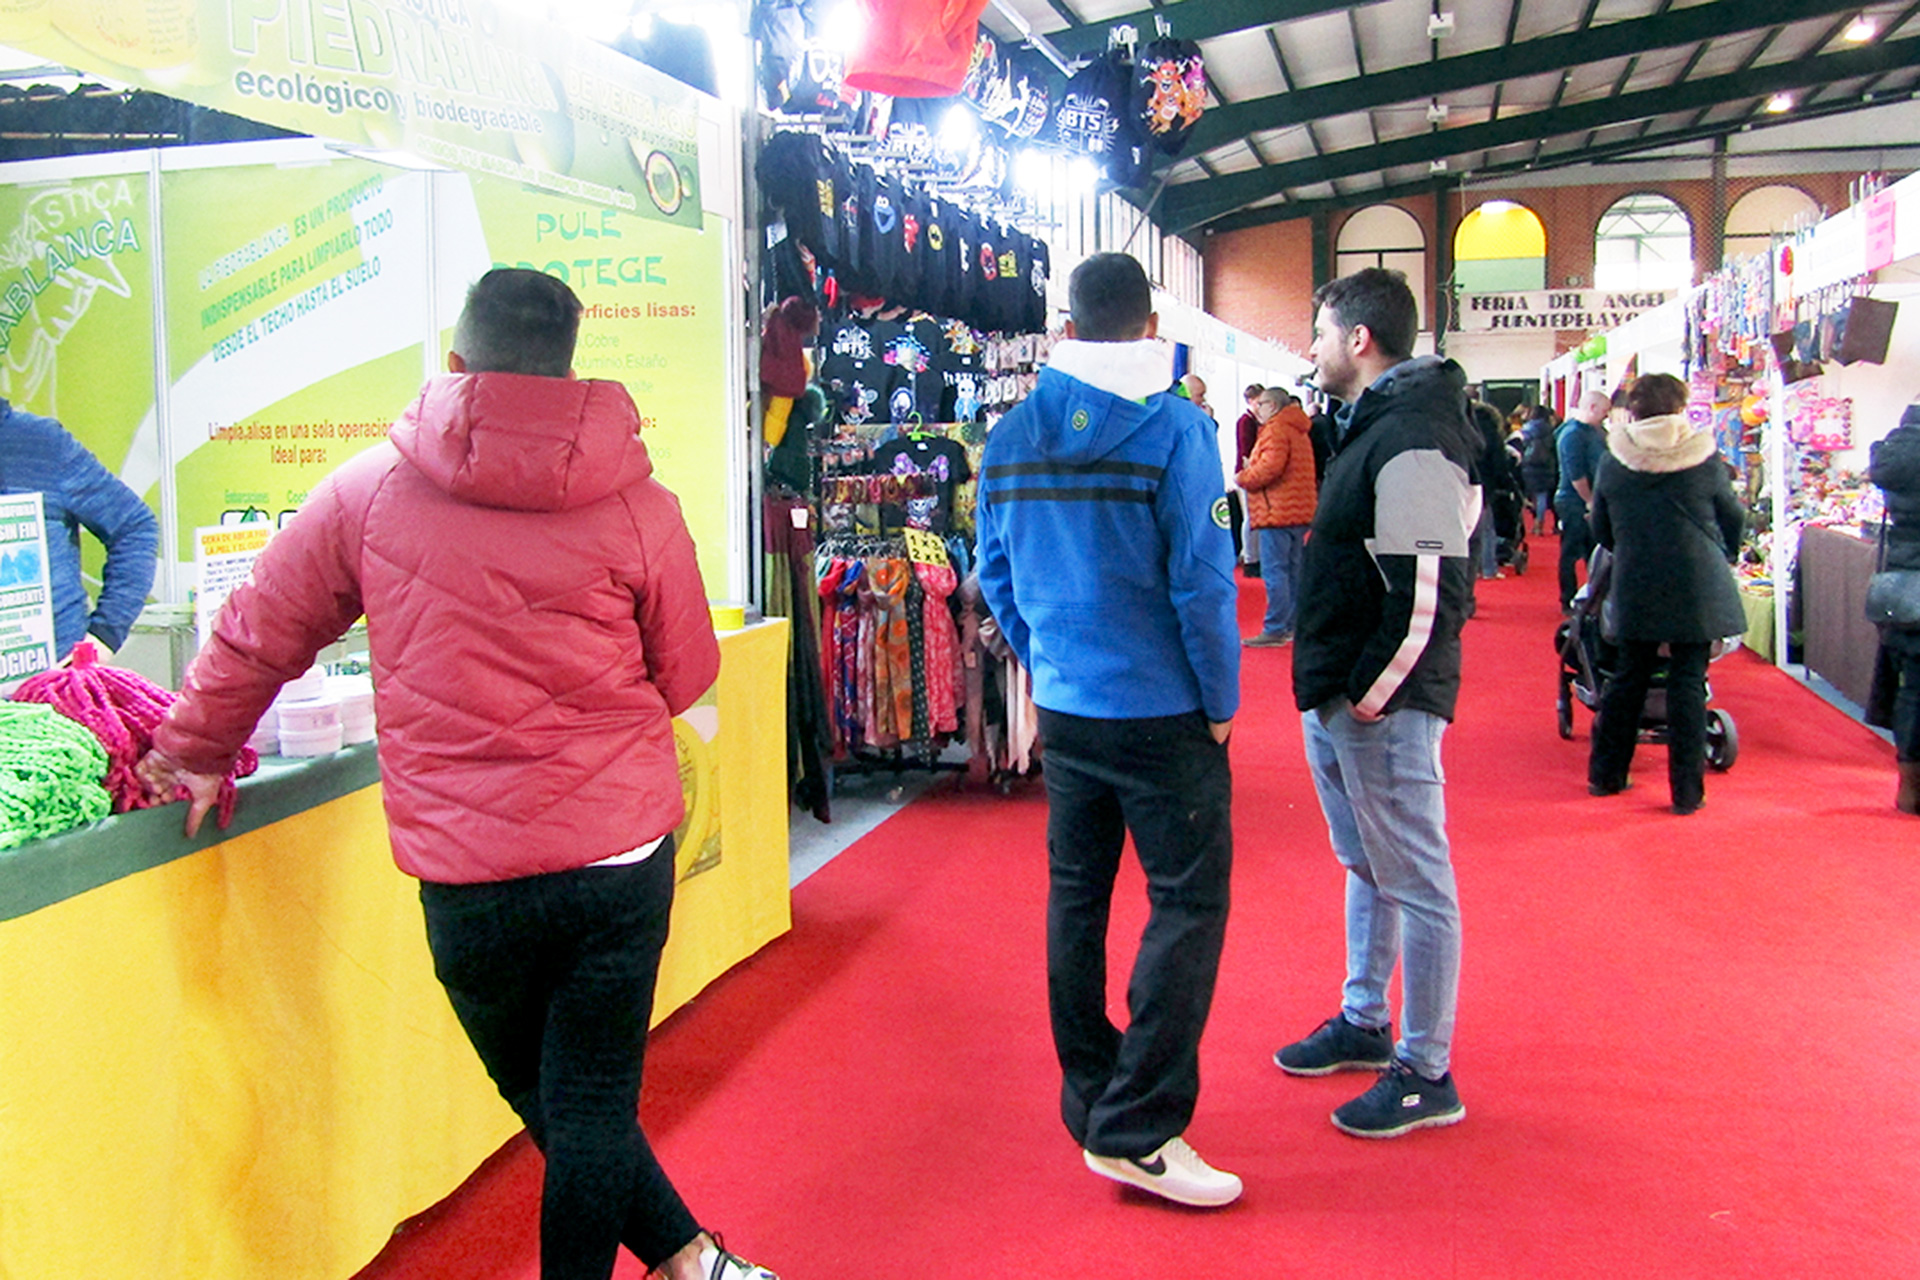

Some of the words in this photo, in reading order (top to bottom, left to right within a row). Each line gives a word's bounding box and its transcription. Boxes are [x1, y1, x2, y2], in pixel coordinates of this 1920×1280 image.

[234, 68, 391, 115] ecológico
[413, 90, 544, 134] biodegradable
[1064, 110, 1102, 132] BTS
[294, 214, 308, 239] ES
[308, 205, 325, 230] UN
[326, 172, 384, 221] PRODUCTO
[536, 210, 622, 243] PULE
[200, 270, 279, 331] INDISPENSABLE
[279, 256, 306, 288] PARA
[306, 225, 362, 271] LIMPIARLO
[363, 207, 394, 240] TODO
[211, 328, 245, 363] DESDE
[246, 321, 260, 345] EL
[260, 301, 296, 337] TECHO
[296, 286, 330, 319] HASTA
[330, 277, 344, 299] EL
[345, 255, 382, 291] SUELO
[647, 302, 696, 318] lisas:
[1470, 295, 1529, 311] FERIA
[1547, 293, 1584, 310] DEL
[274, 425, 288, 440] en
[289, 425, 309, 440] una
[312, 419, 335, 439] sola
[270, 444, 298, 465] Ideal
